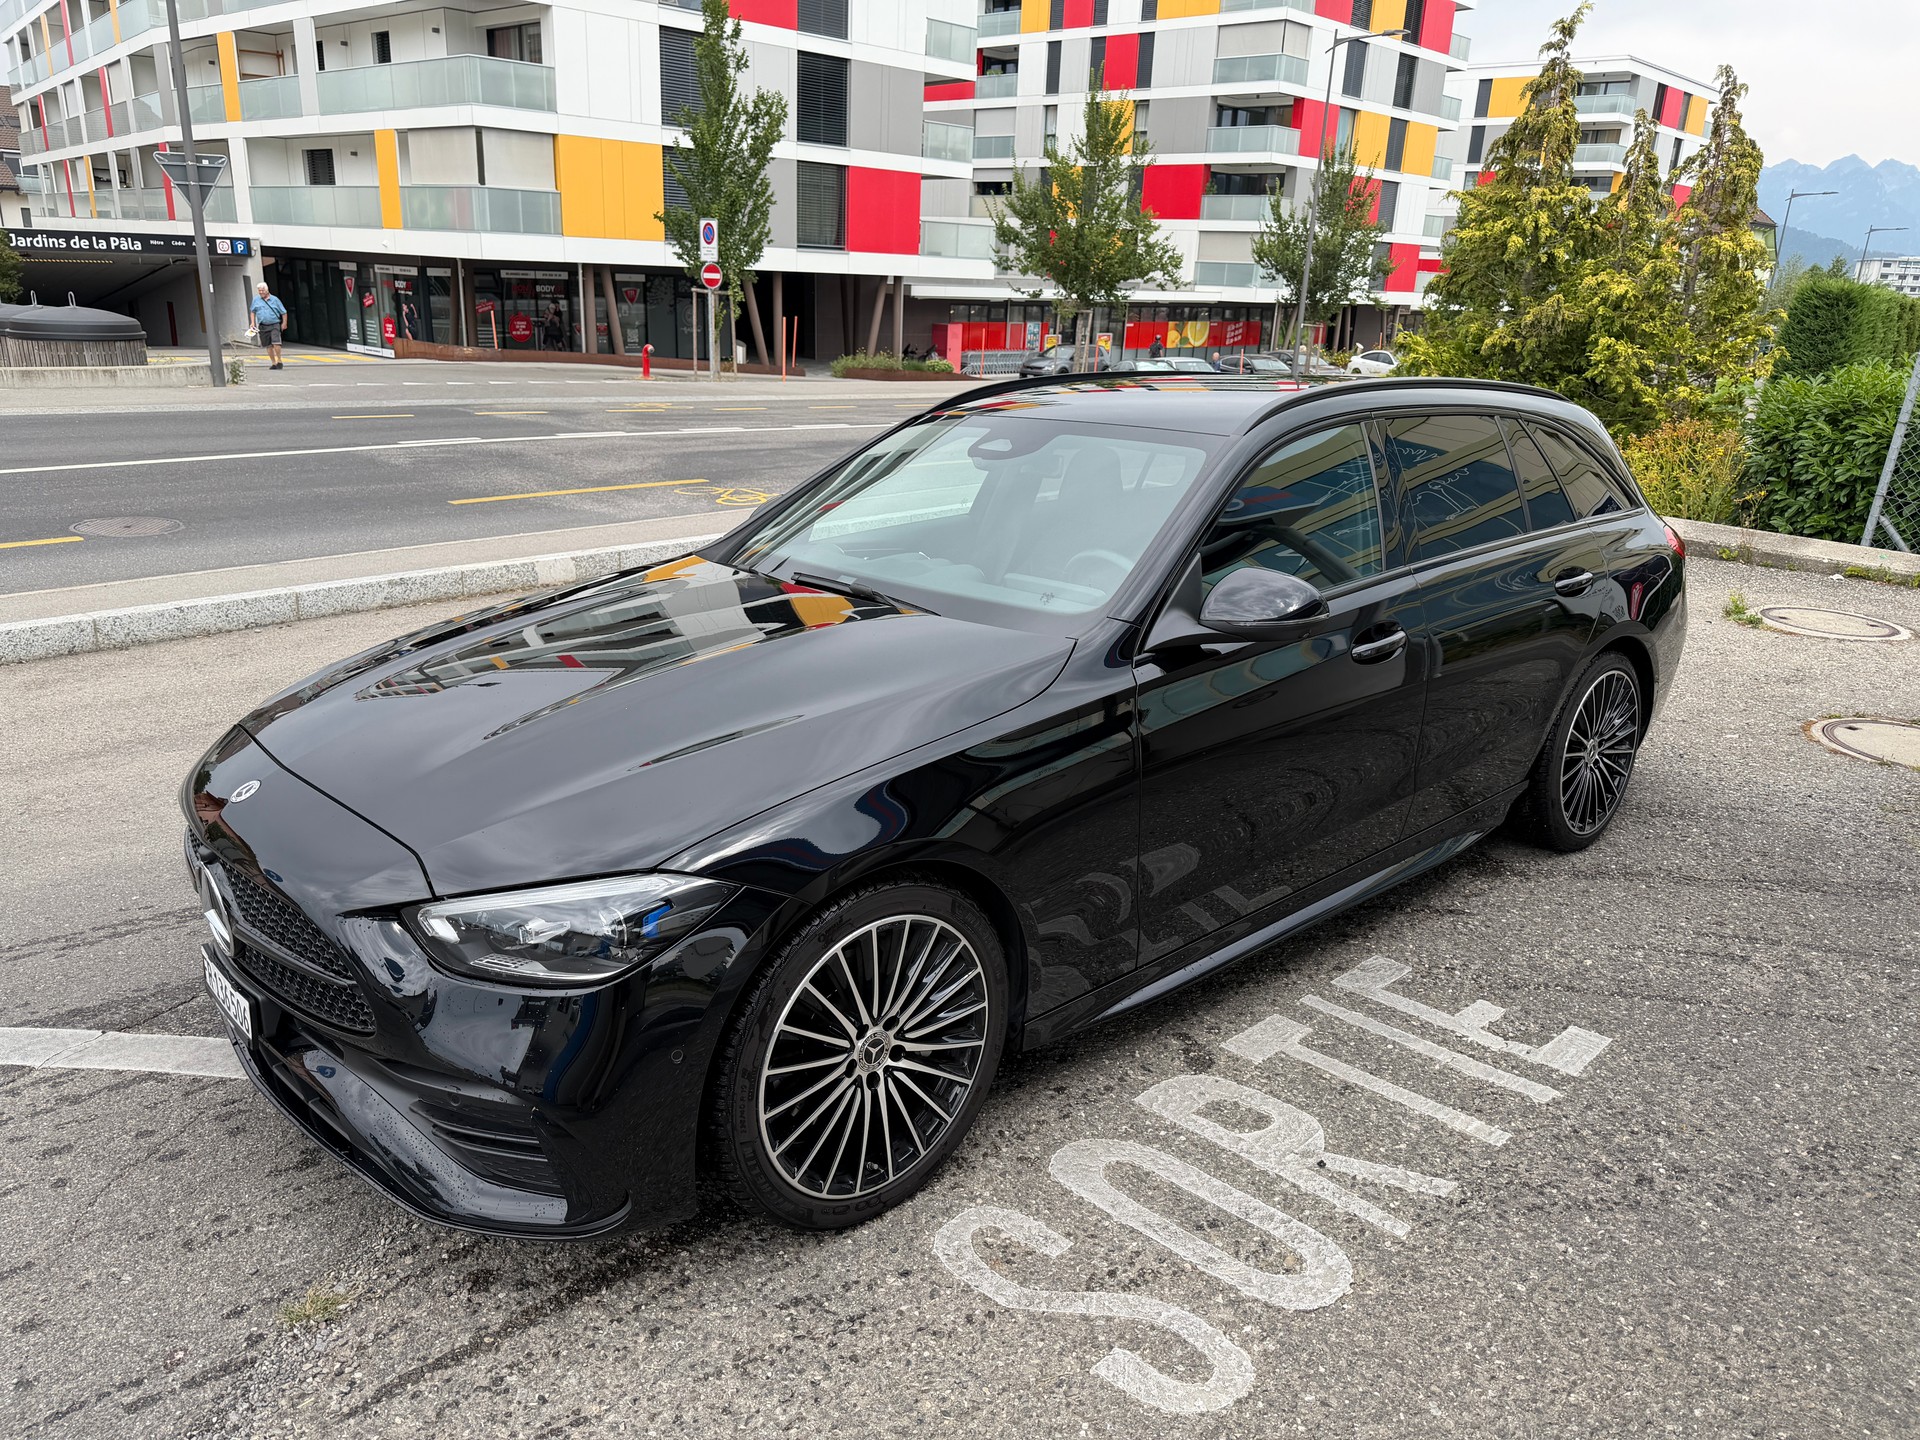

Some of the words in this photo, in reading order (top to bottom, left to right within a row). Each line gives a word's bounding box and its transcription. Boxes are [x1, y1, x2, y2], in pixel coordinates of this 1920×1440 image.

[9, 233, 67, 248] Jardins
[70, 235, 90, 249] de
[92, 236, 107, 250] la
[110, 236, 142, 251] Pâla
[933, 955, 1613, 1414] SORTIE
